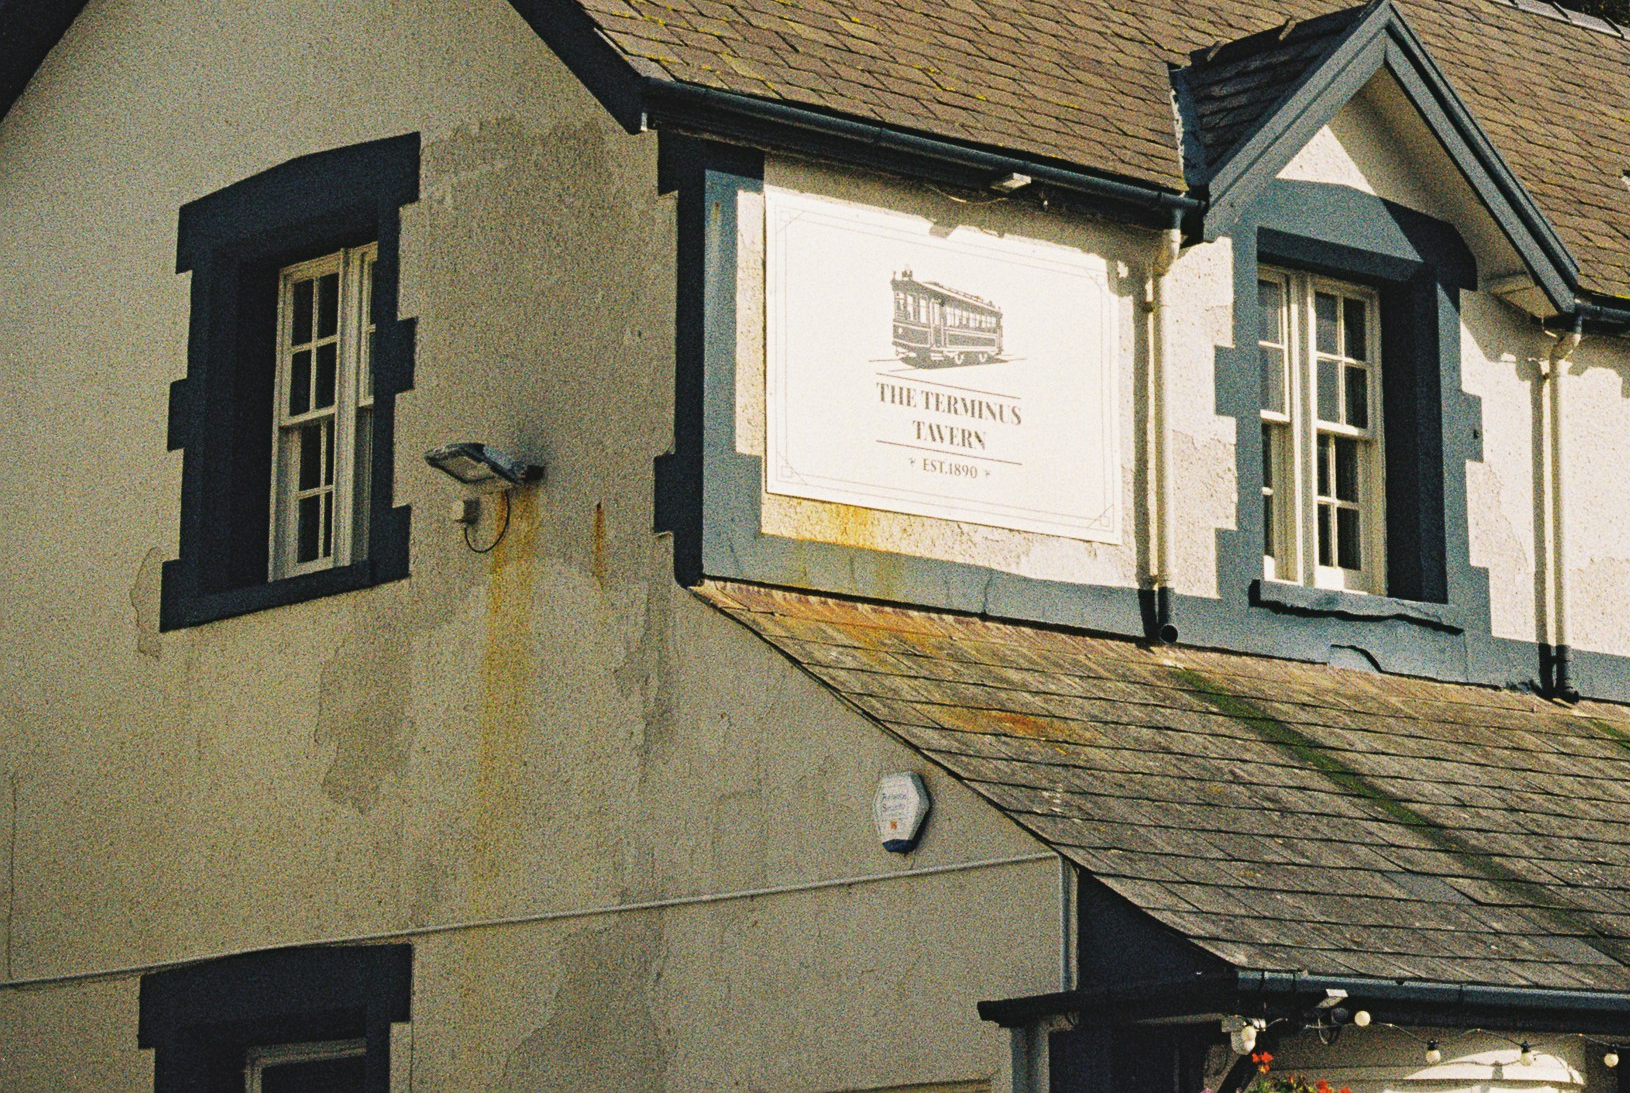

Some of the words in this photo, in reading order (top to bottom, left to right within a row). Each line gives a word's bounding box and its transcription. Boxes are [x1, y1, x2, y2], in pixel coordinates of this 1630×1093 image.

[876, 382, 917, 409] THE
[921, 390, 1022, 425] TERMINUS
[913, 420, 986, 450] TAVERN
